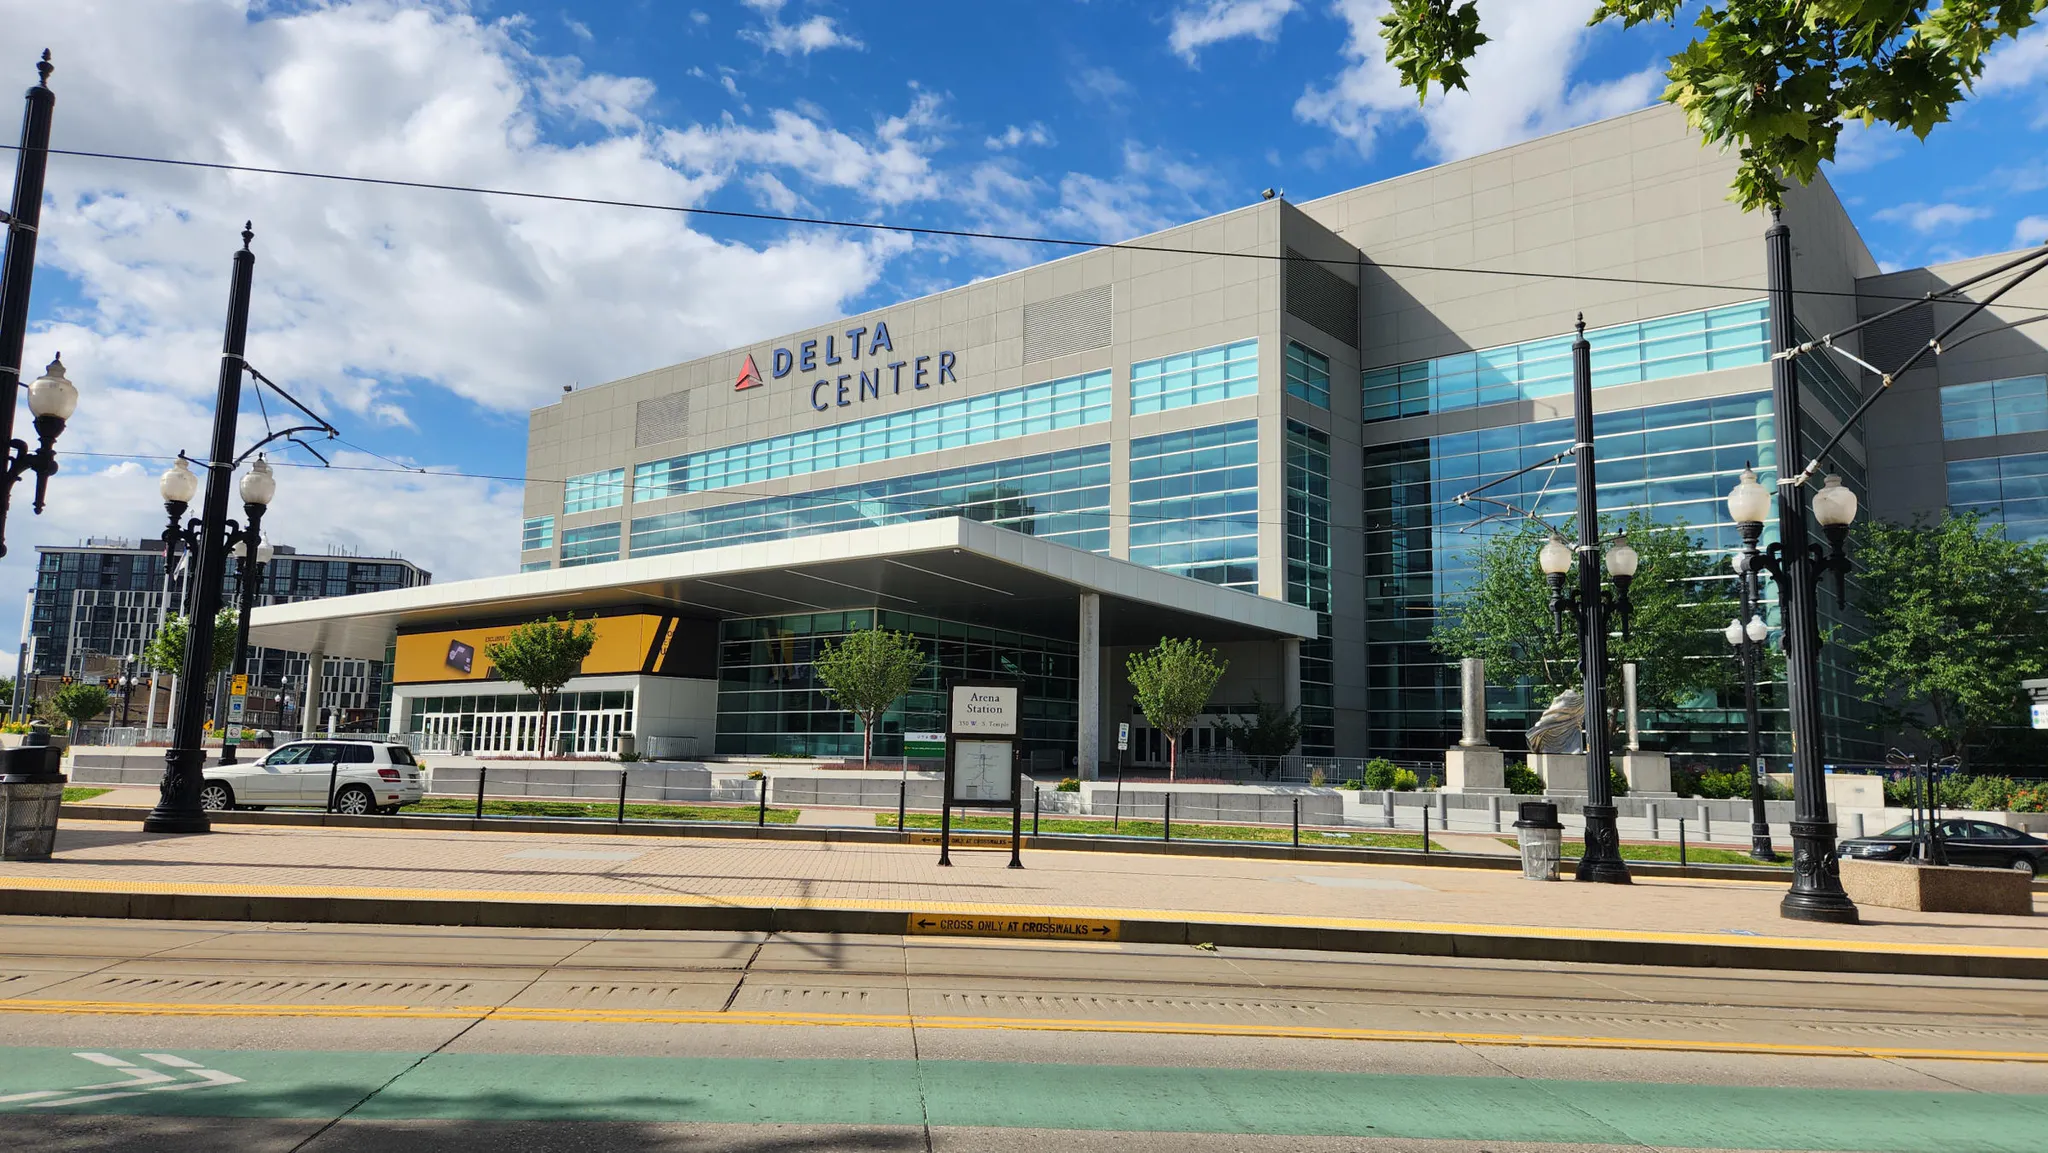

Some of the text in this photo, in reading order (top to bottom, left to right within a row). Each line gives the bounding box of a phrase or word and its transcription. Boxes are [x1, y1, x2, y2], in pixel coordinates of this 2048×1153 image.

[772, 321, 893, 379] DELTA
[810, 350, 957, 412] CENTER
[970, 692, 1000, 702] Arena
[967, 703, 1003, 714] Station
[940, 919, 1089, 935] CROSS ONLY AT CROSSWALKS
